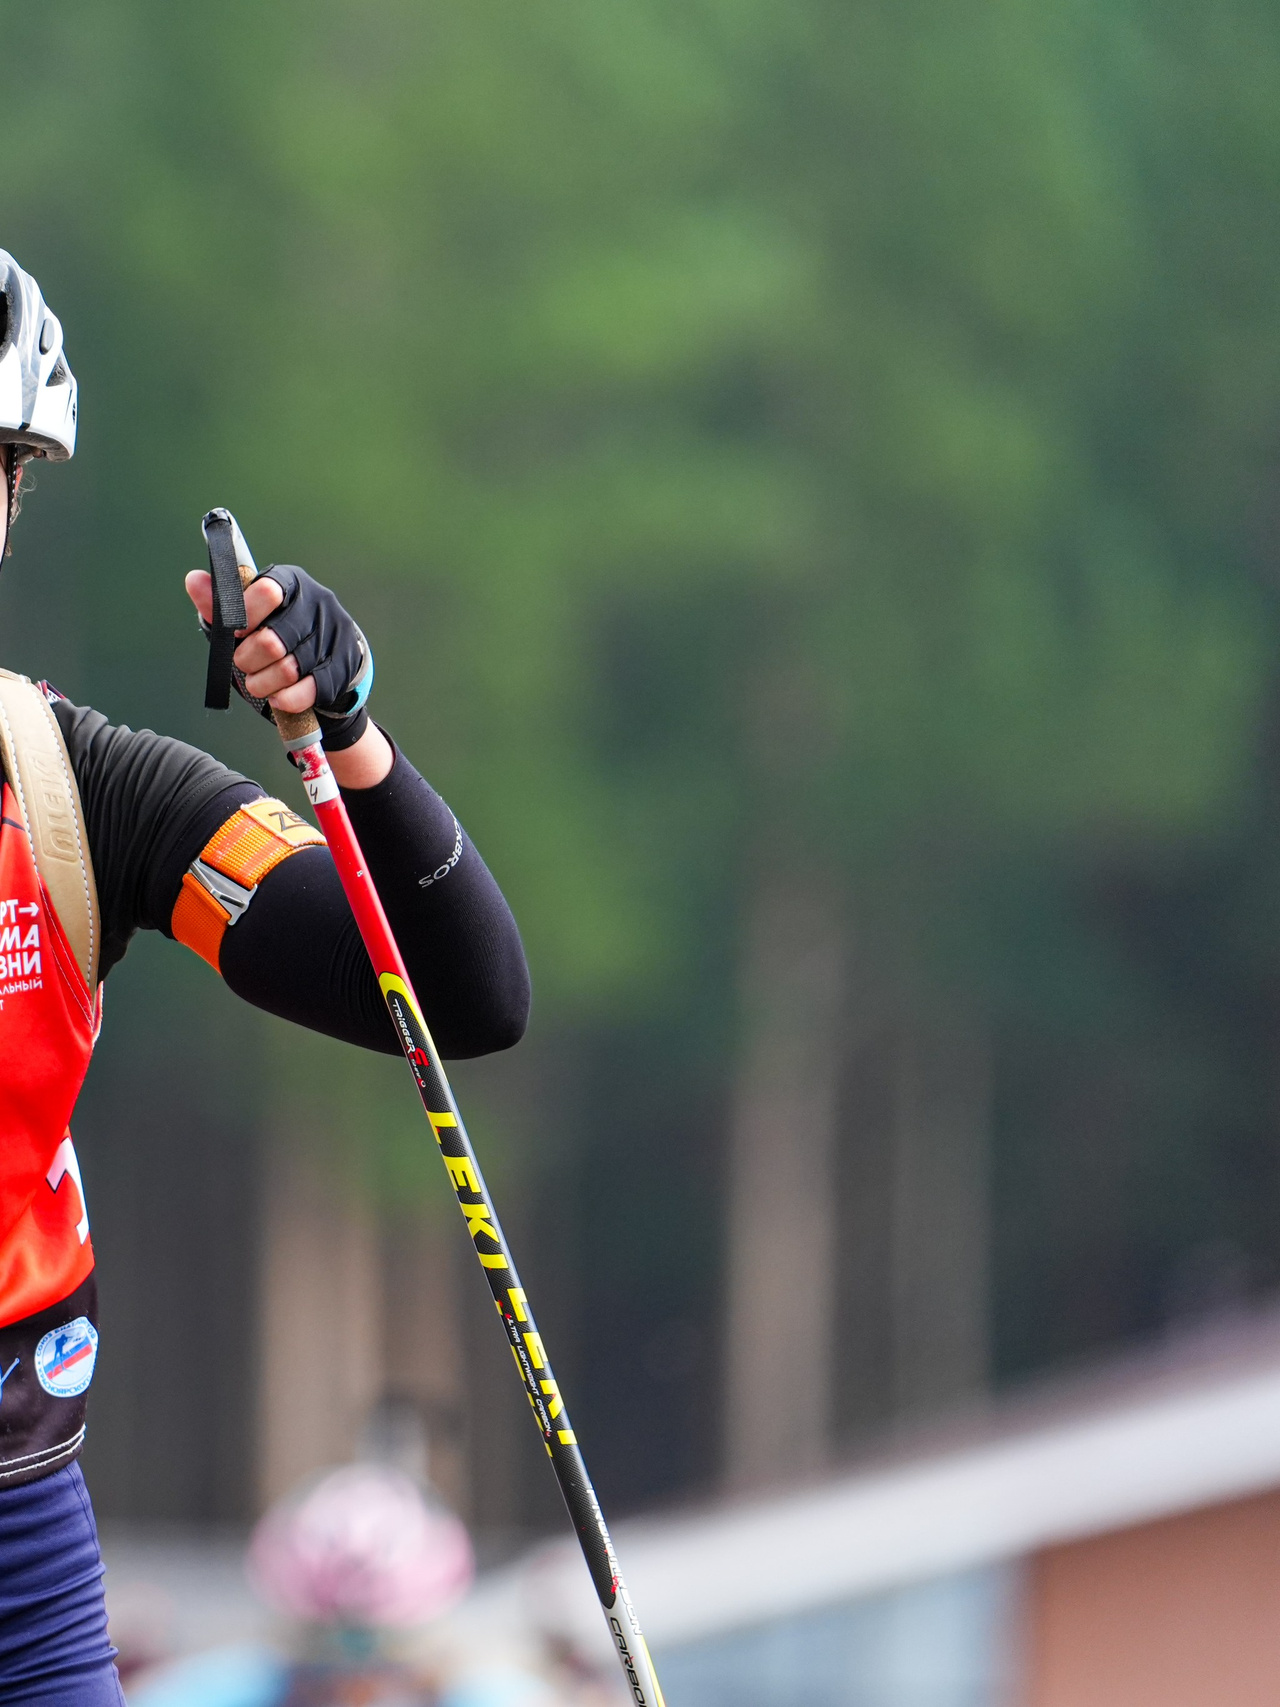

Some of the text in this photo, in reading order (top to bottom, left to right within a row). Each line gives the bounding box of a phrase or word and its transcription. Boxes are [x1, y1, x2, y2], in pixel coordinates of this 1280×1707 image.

[418, 812, 463, 888] CKBROS
[393, 999, 416, 1055] TRIGGER
[427, 1111, 510, 1269] LEKI
